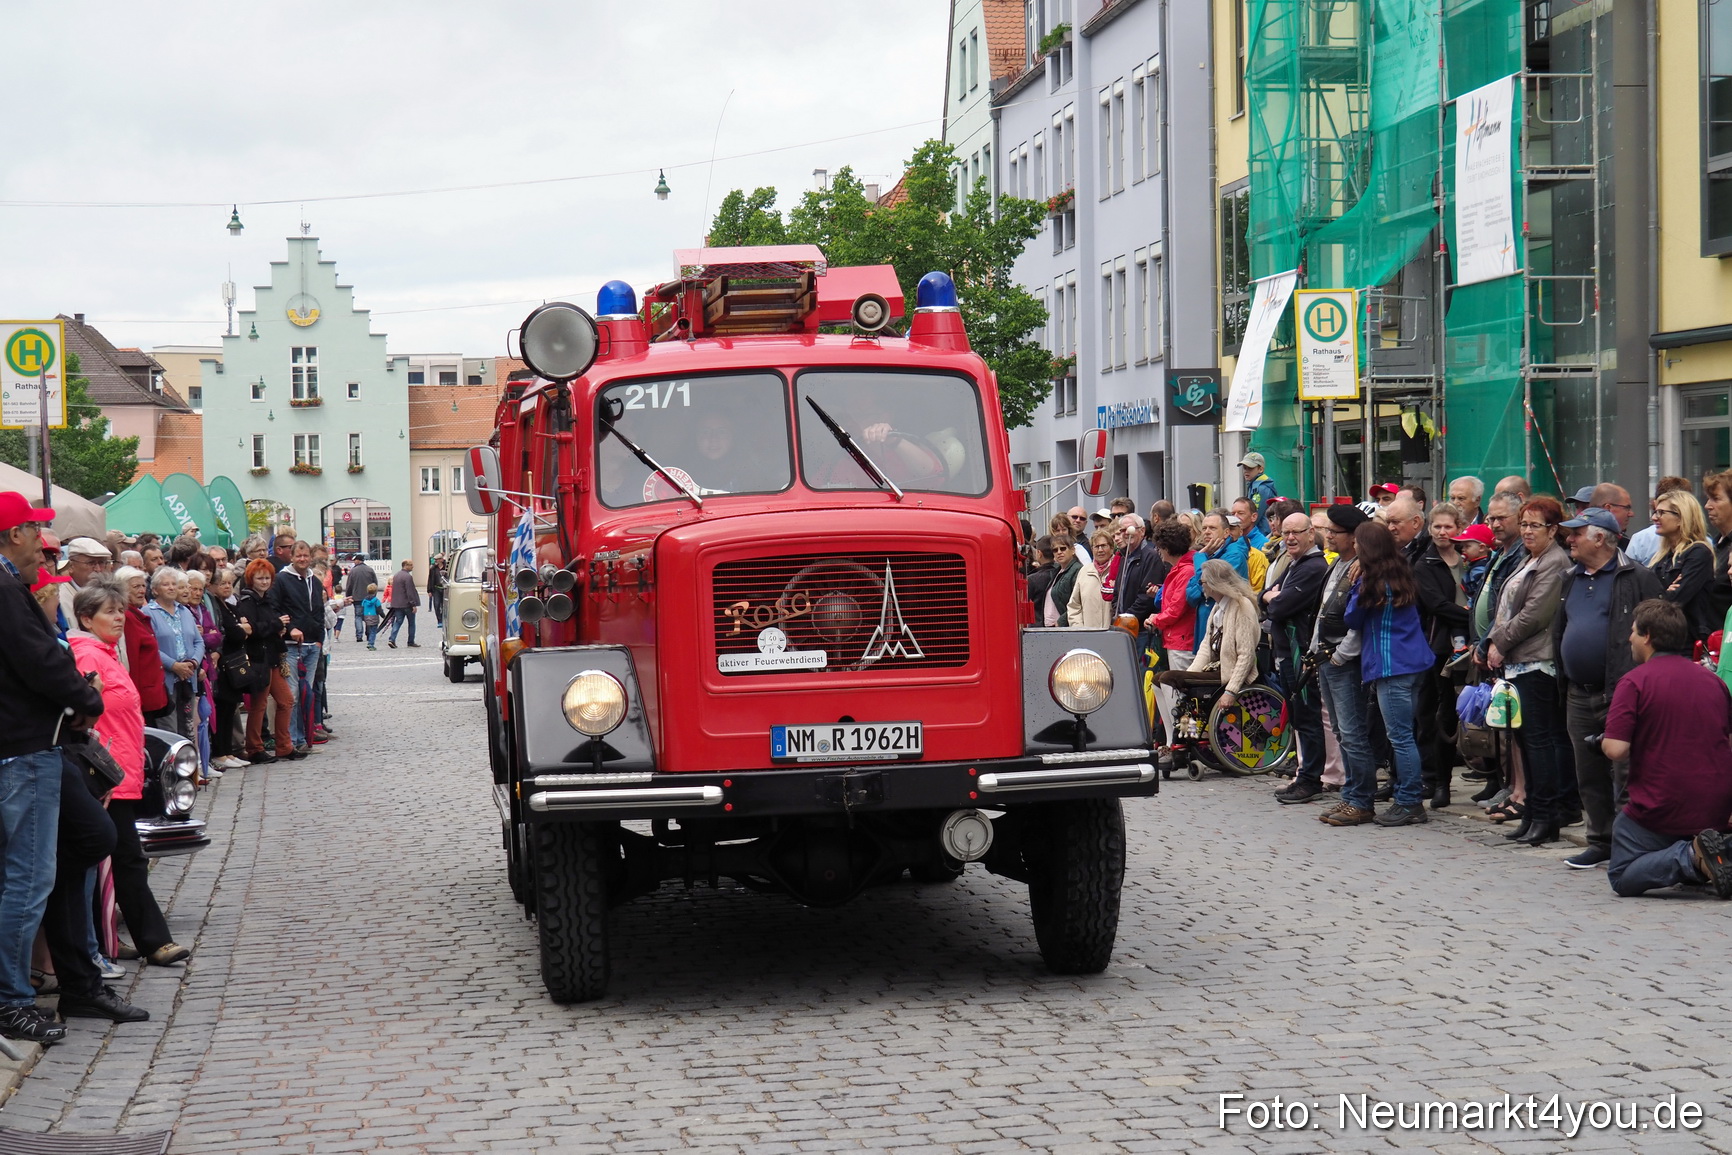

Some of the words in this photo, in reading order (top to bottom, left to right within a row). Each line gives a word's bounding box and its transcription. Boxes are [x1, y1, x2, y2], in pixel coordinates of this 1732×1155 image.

[1317, 307, 1335, 332] H
[19, 340, 42, 365] H
[625, 382, 691, 410] 21/1
[1186, 383, 1205, 407] G2
[1108, 397, 1152, 428] Raiffeisenbank
[720, 659, 749, 668] aktiver
[754, 655, 824, 666] Feuerwehrdienst
[776, 744, 782, 752] D
[787, 728, 815, 753] NM
[832, 728, 846, 751] R
[850, 725, 919, 751] 1962H
